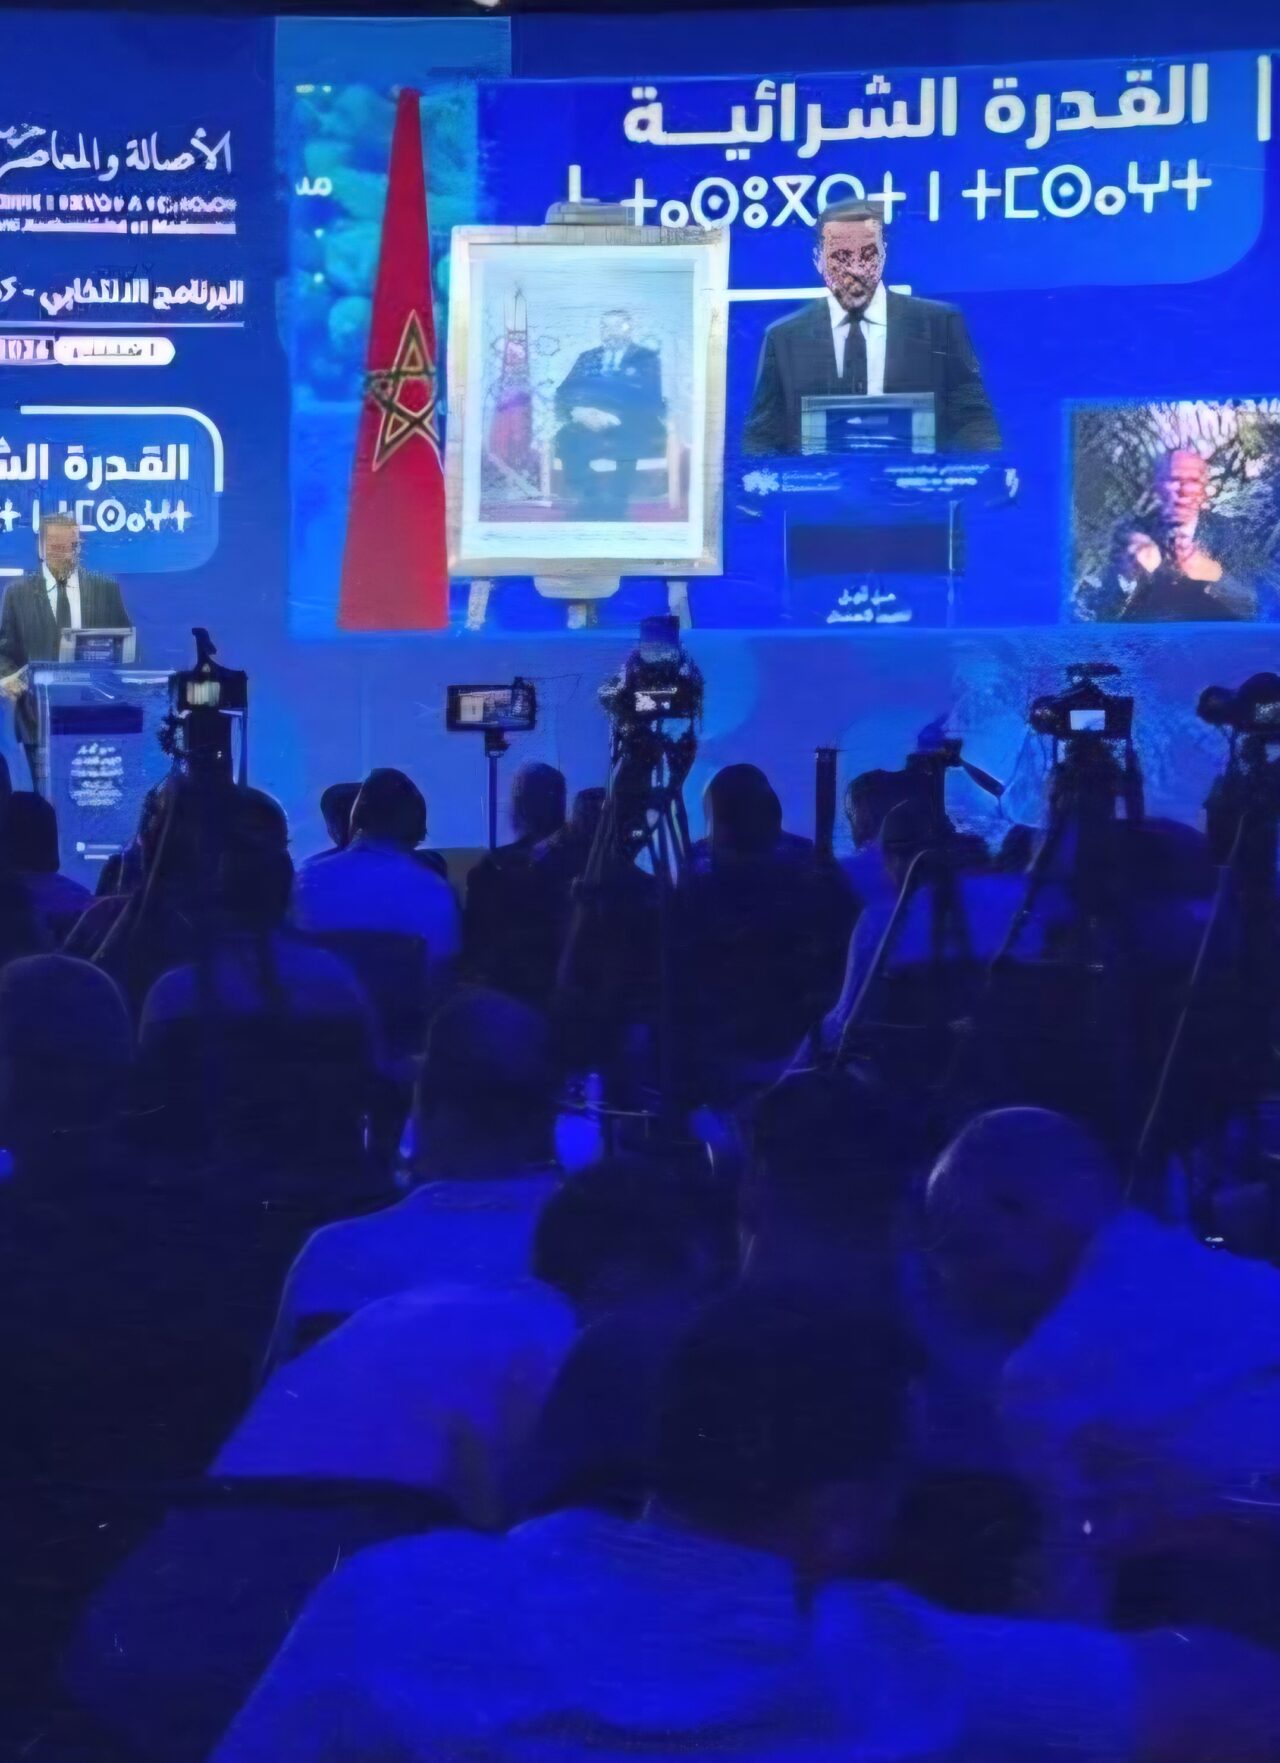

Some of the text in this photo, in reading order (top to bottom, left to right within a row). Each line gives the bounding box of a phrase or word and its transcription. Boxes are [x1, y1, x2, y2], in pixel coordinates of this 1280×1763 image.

[623, 62, 1209, 162] القدرة الشرائية
[125, 126, 232, 175] الأصالة
[63, 442, 190, 491] القدرة
